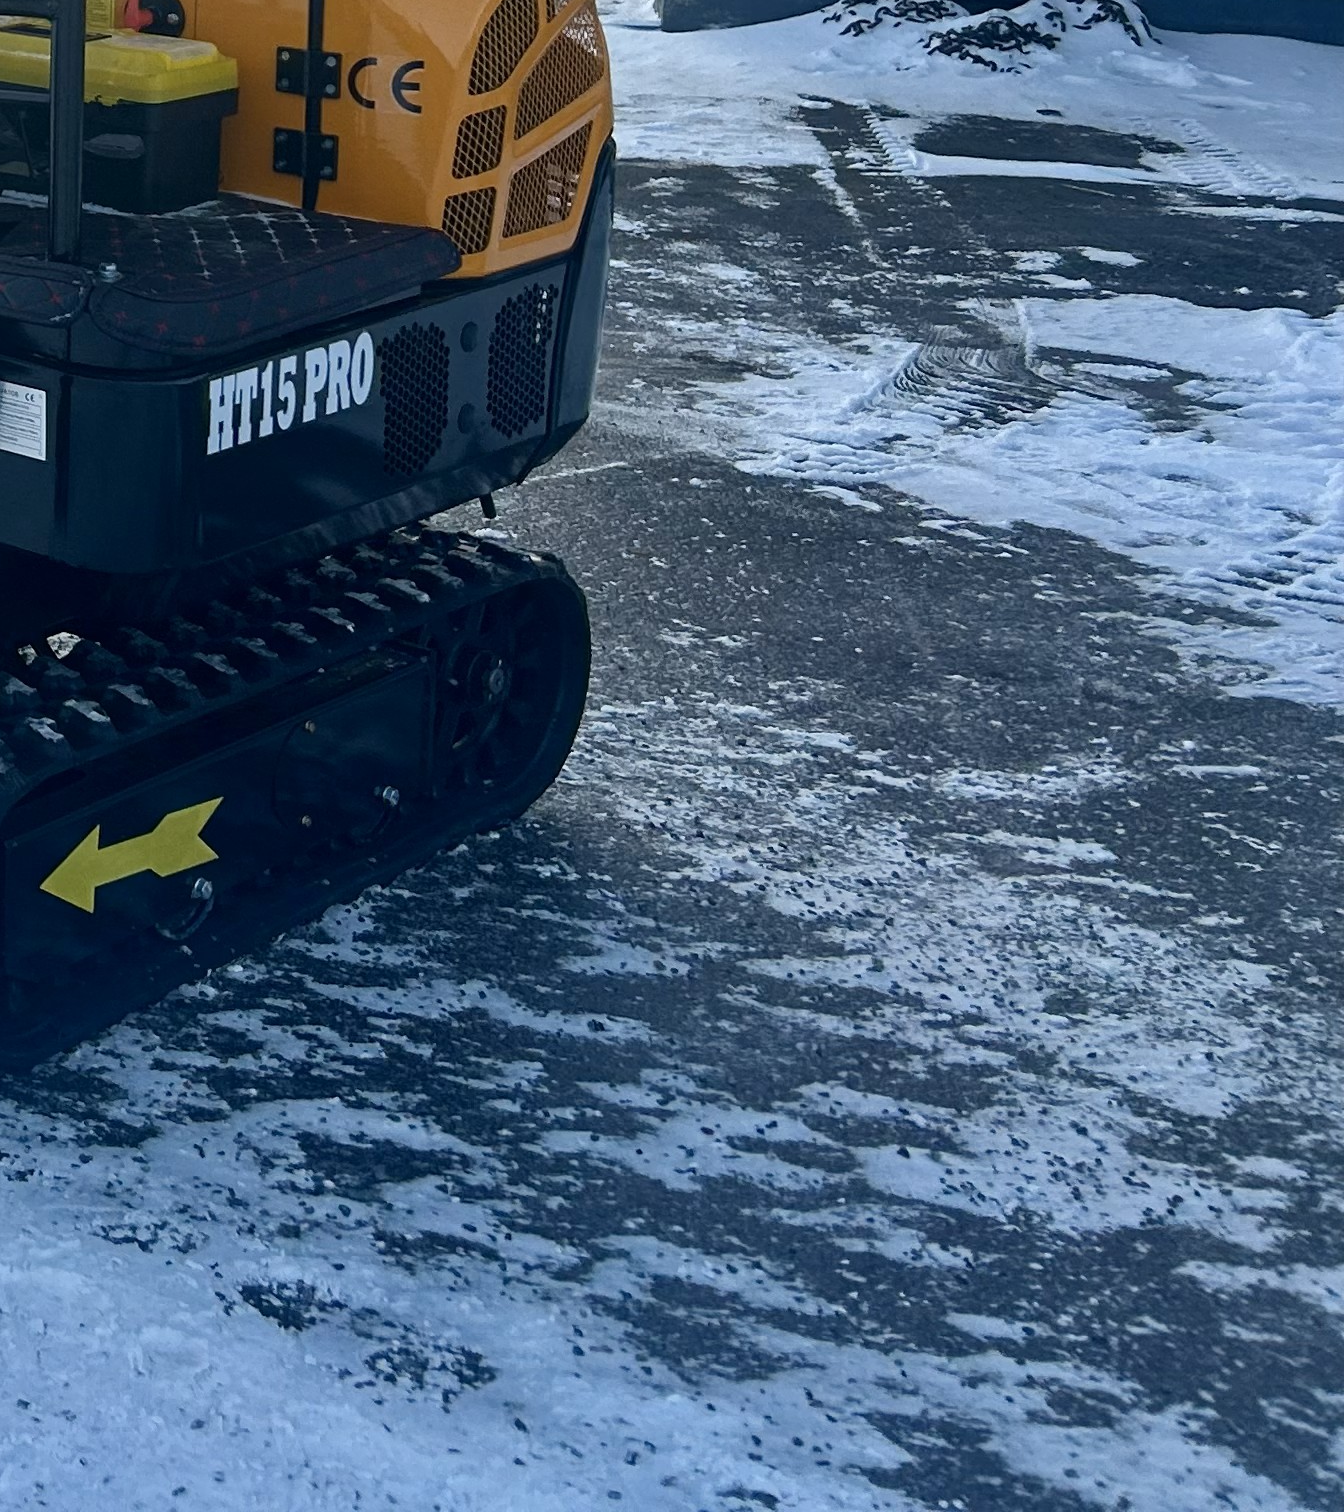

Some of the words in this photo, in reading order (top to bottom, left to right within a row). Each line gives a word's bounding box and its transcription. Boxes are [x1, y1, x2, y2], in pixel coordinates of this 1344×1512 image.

[348, 57, 425, 114] CE
[207, 355, 297, 455] HT15
[302, 331, 374, 423] PRO
